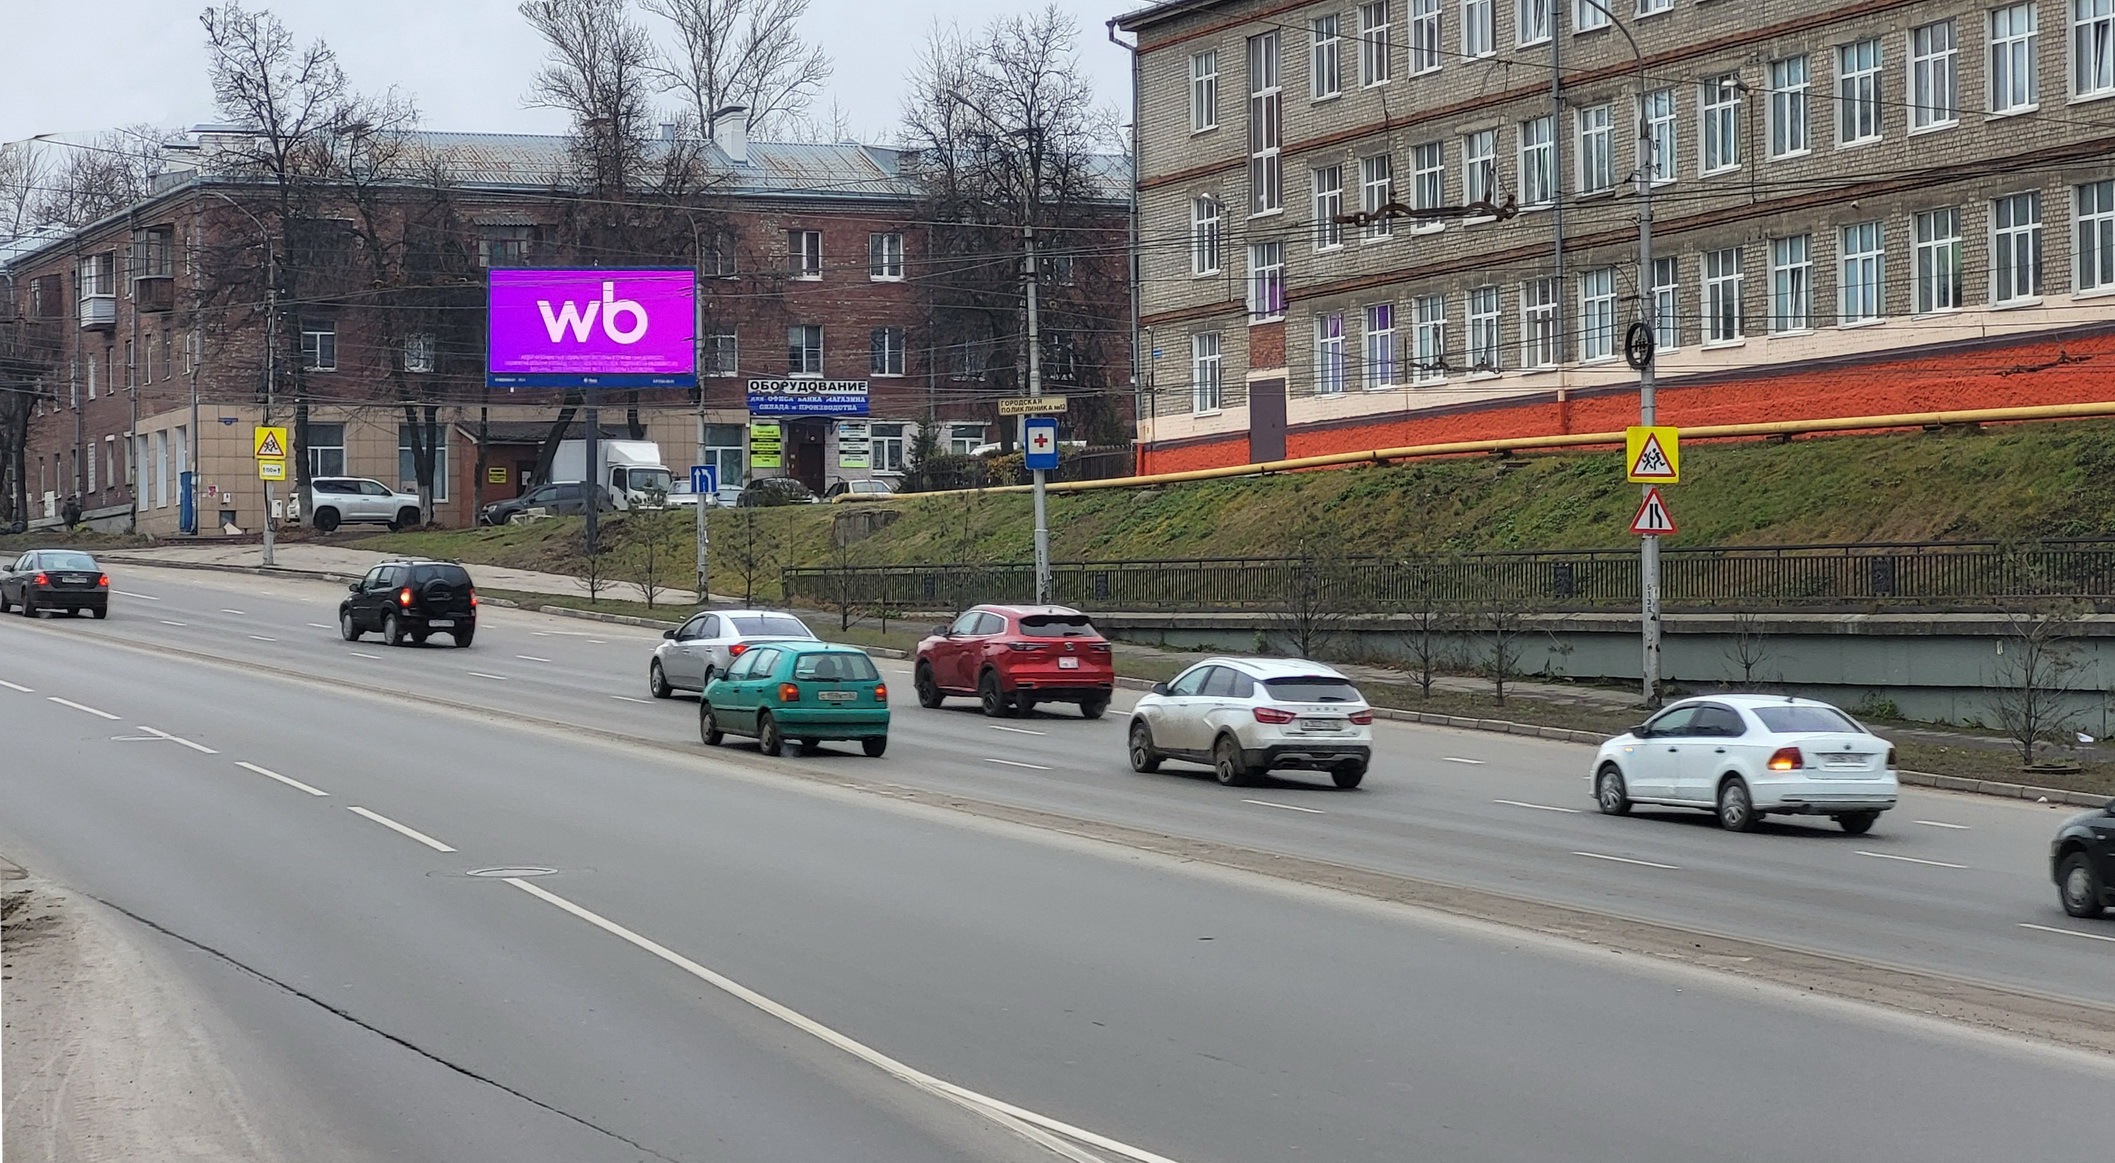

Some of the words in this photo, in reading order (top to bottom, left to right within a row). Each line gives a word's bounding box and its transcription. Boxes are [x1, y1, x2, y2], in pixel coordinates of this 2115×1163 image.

[537, 281, 649, 345] wb
[750, 381, 866, 392] ОБОРУДОВАНИЕ
[1001, 405, 1053, 413] ПОЛИКЛИНИКА
